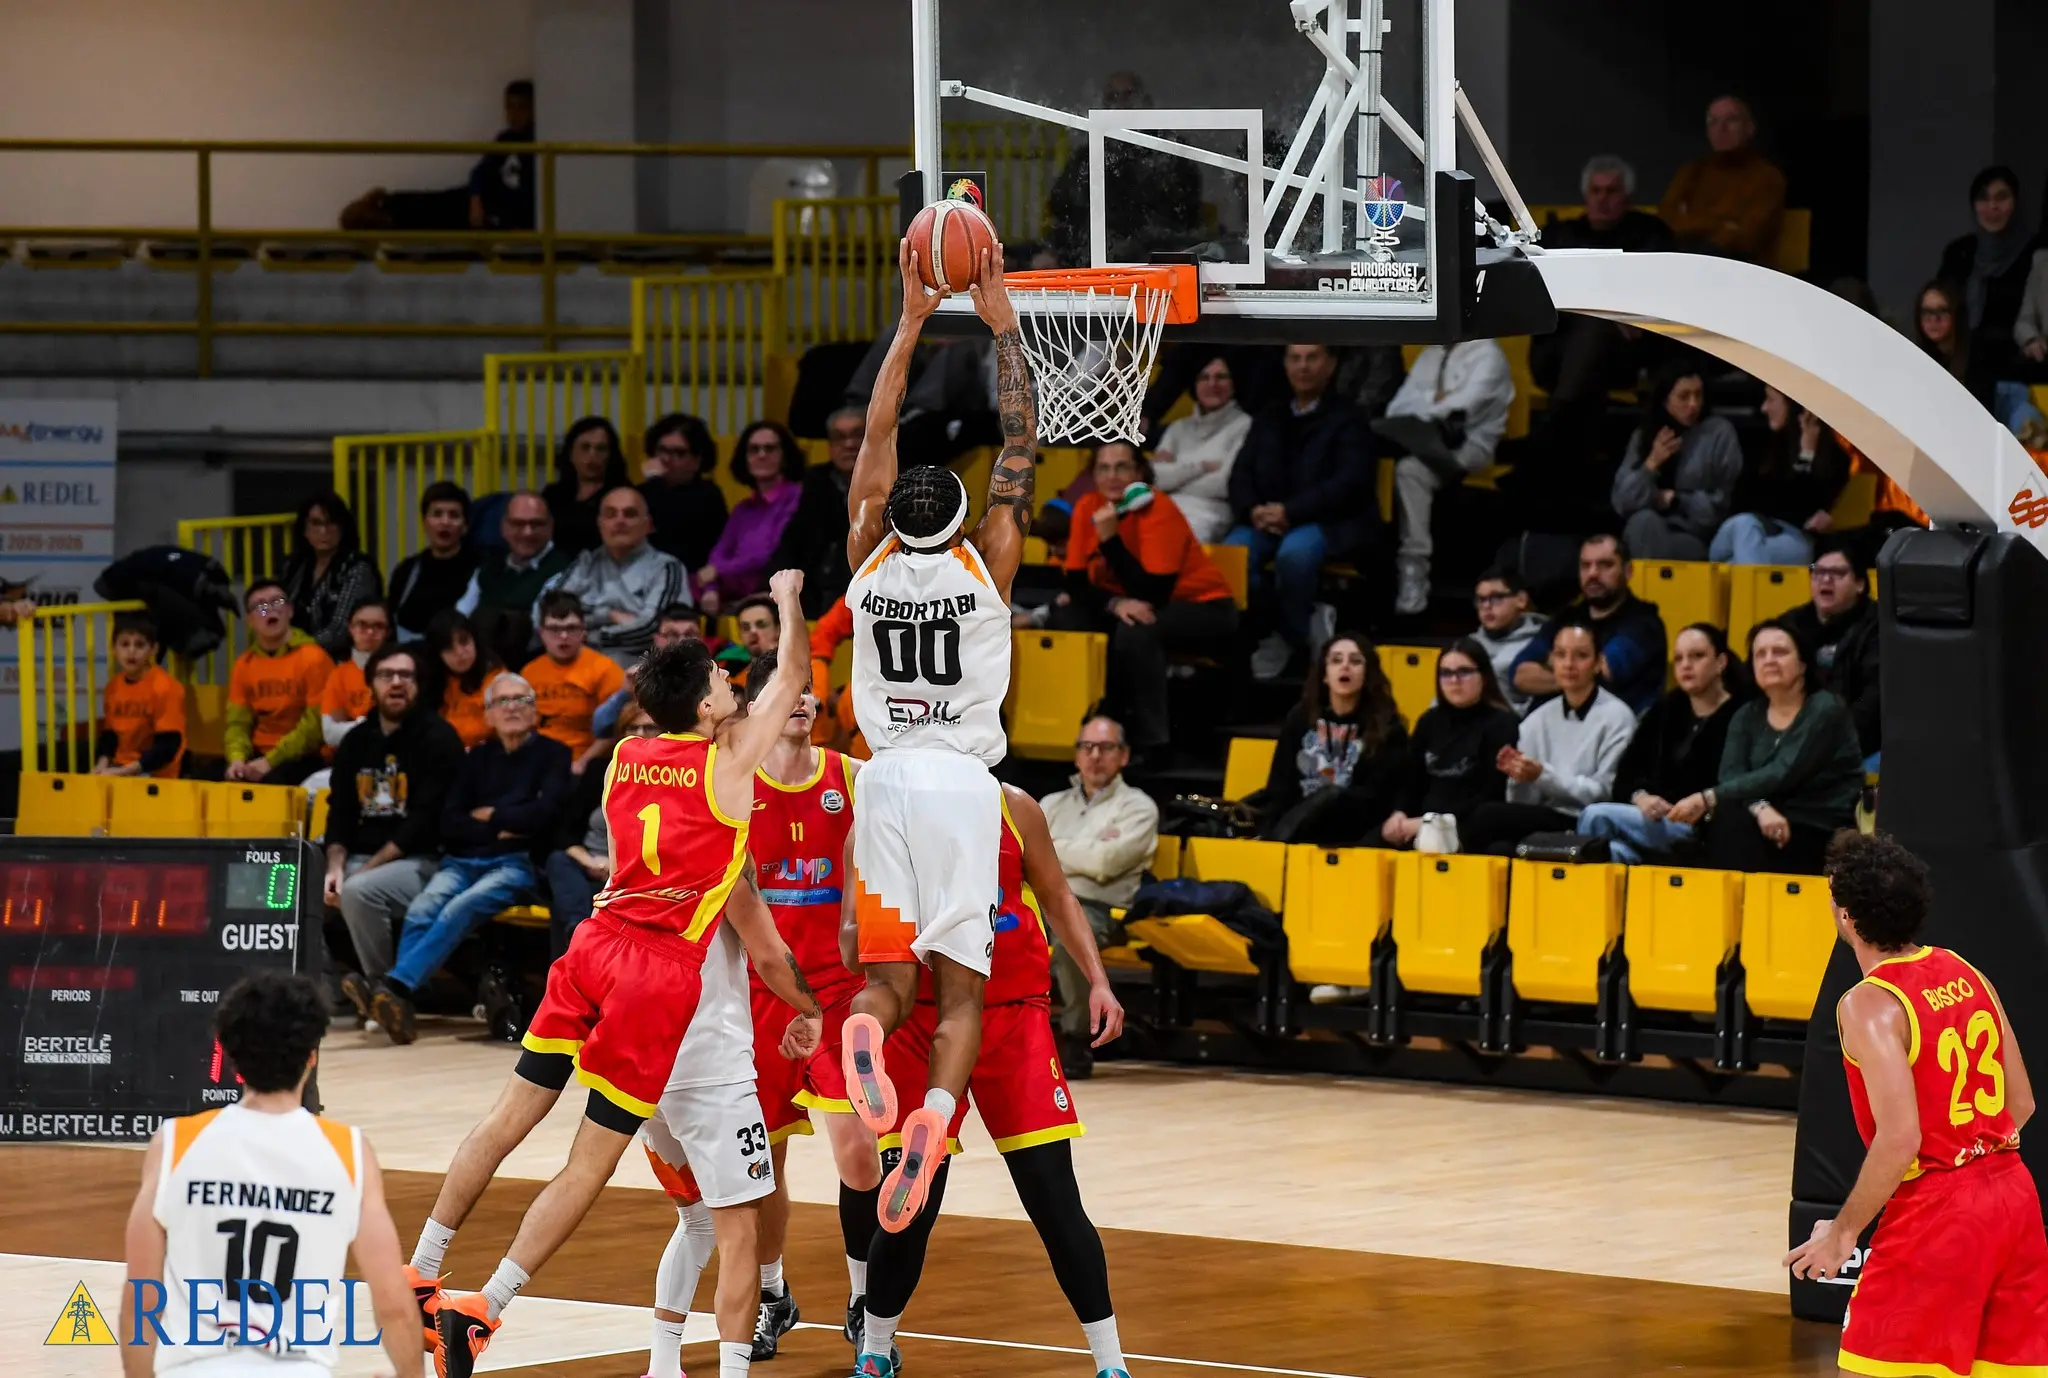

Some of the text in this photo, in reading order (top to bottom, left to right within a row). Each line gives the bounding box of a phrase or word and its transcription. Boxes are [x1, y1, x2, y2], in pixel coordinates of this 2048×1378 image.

[1351, 262, 1419, 277] EUROBASKET
[23, 481, 102, 505] REDEL
[860, 589, 977, 620] AGBORTABI
[872, 618, 963, 686] 00
[617, 762, 697, 788] LO IACONO
[636, 803, 661, 876] 1
[789, 822, 804, 842] 11
[246, 851, 281, 864] FOULS
[267, 864, 296, 909] 0
[222, 923, 300, 951] GUEST
[51, 989, 91, 1002] PERIODS
[180, 990, 219, 1003] TIME OUT
[1921, 977, 1975, 1012] BUSCO
[24, 1053, 111, 1064] ELECTRONICS
[1049, 1057, 1060, 1080] 8
[1938, 1009, 2005, 1128] 23
[202, 1088, 239, 1102] POINTS
[736, 1121, 767, 1158] 33
[187, 1180, 336, 1216] FERNANDEZ
[216, 1217, 299, 1304] 10
